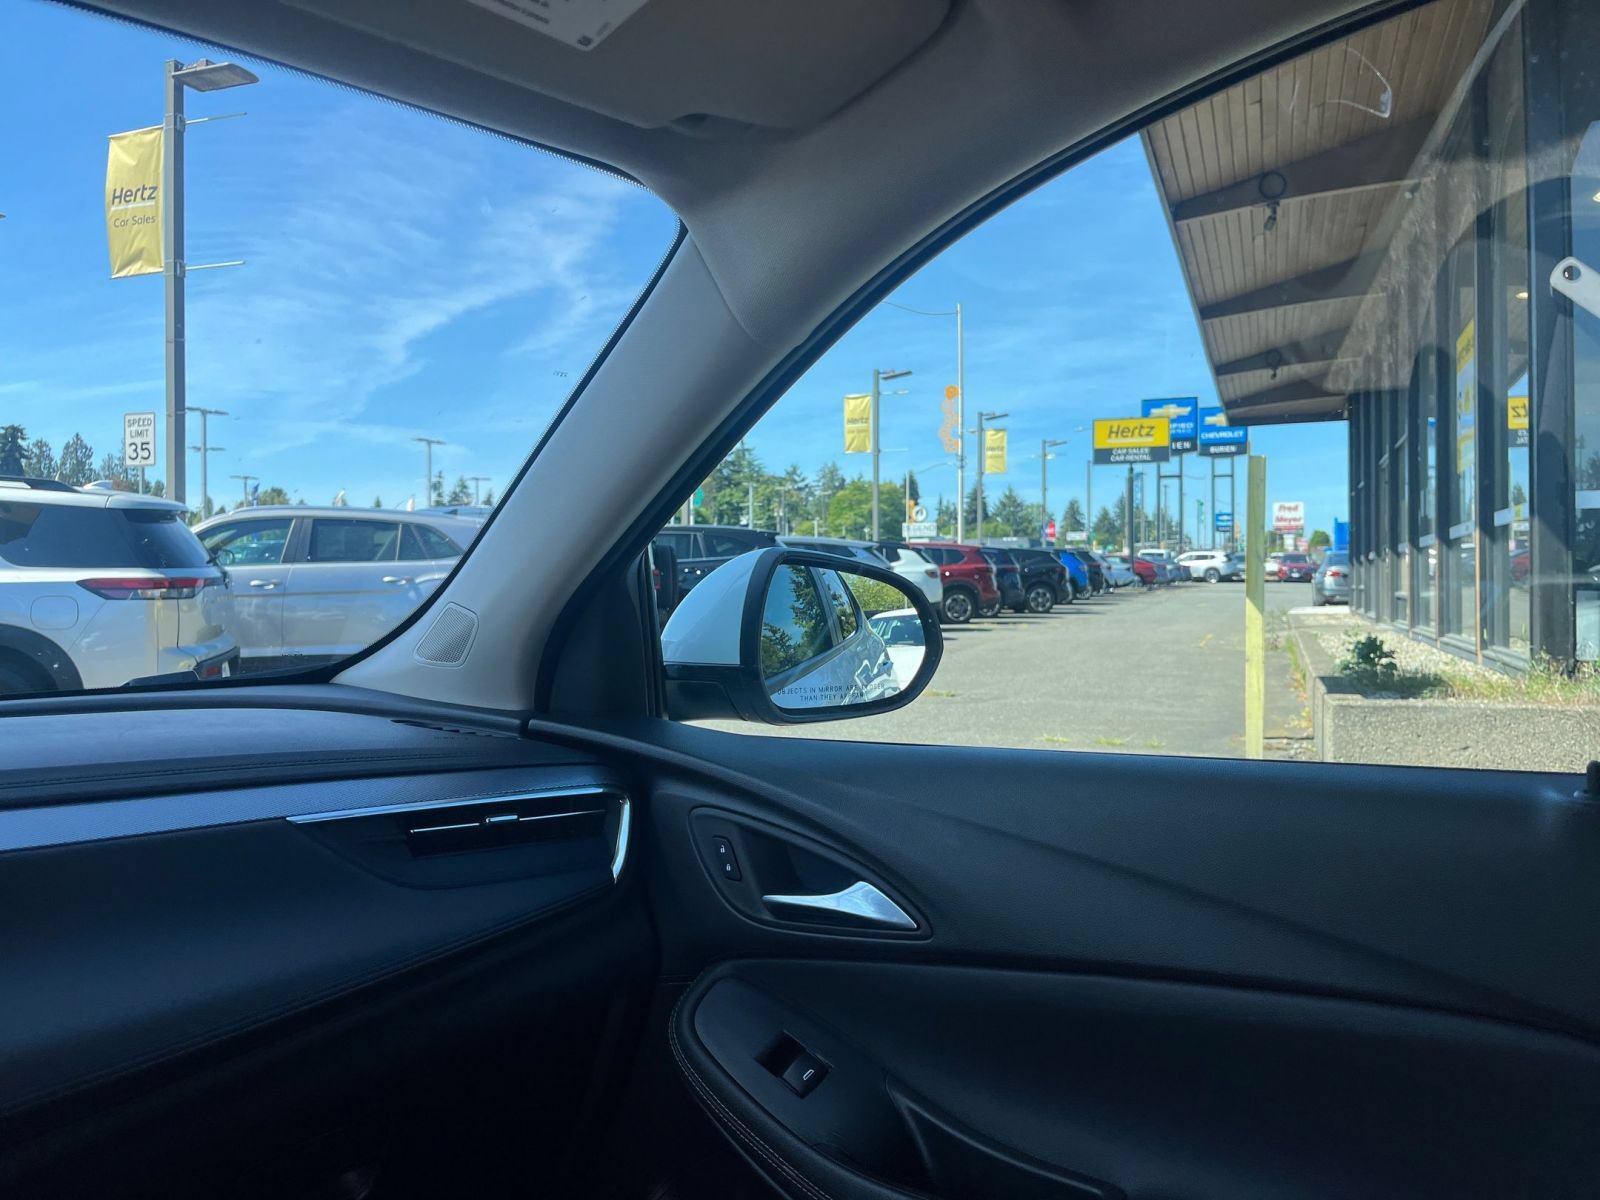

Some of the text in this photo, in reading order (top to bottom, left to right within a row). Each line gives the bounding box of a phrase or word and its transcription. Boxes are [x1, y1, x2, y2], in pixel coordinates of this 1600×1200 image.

[111, 184, 158, 205] Hertz
[113, 215, 156, 228] Car Sales
[127, 417, 152, 428] SPEED
[130, 429, 149, 438] LIMIT
[1108, 424, 1155, 438] Hertz
[1200, 430, 1243, 440] CHEVROLET
[128, 442, 151, 460] 35
[1128, 446, 1150, 454] SALES
[1110, 454, 1125, 462] CAR
[778, 687, 808, 695] OBJECTS
[818, 684, 843, 693] MIRROR
[800, 694, 818, 702] THAN
[821, 692, 837, 700] THEY
